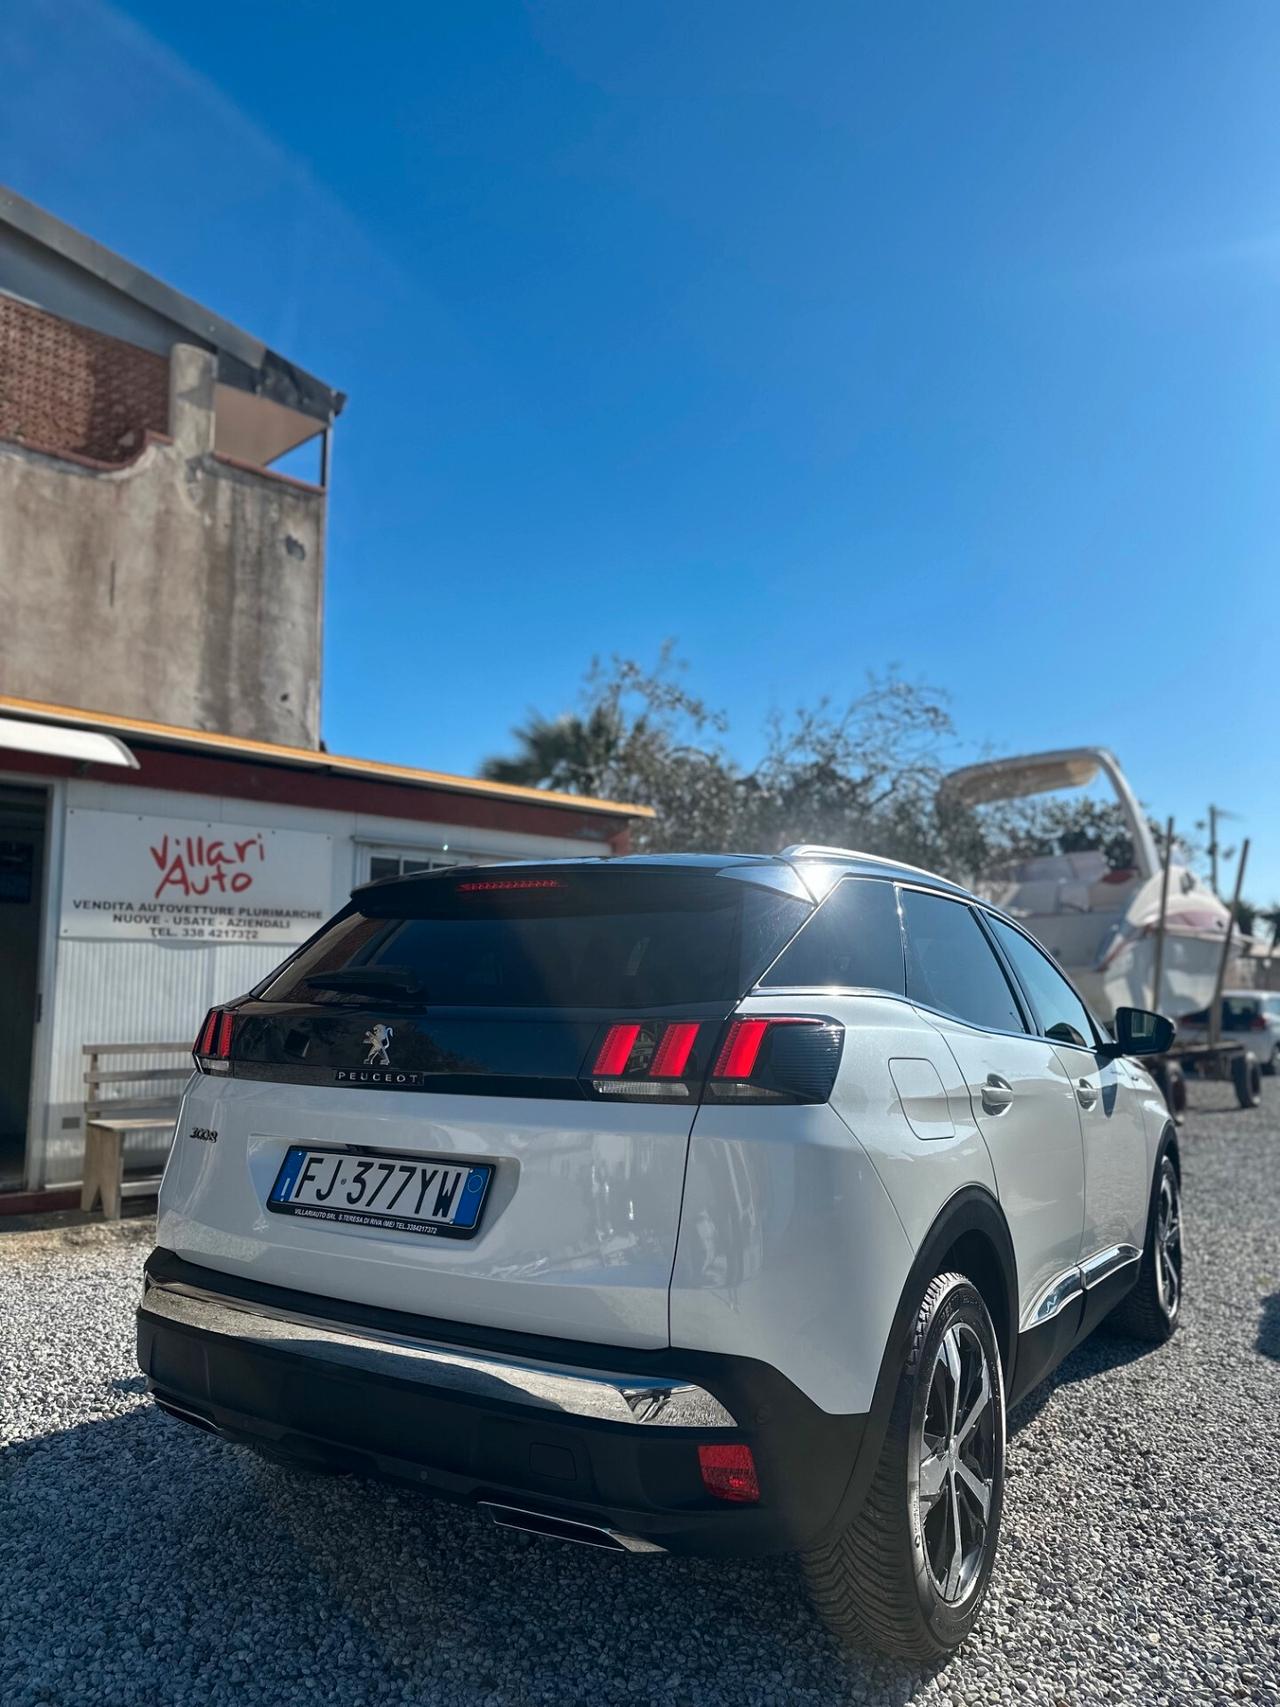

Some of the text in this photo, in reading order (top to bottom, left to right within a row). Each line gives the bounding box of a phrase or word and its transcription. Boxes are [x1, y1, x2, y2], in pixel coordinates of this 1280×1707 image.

[150, 833, 265, 871] Villari
[154, 856, 253, 899] Auto
[72, 899, 323, 919] VENDITA AUTOVETTURE PLURIMARCHE
[113, 914, 160, 925] NUOVE
[173, 916, 216, 927] USATE
[227, 918, 291, 929] AZIENDALI
[182, 928, 205, 937] 338
[208, 929, 259, 939] 4217372
[338, 1071, 419, 1084] PEUGEOT
